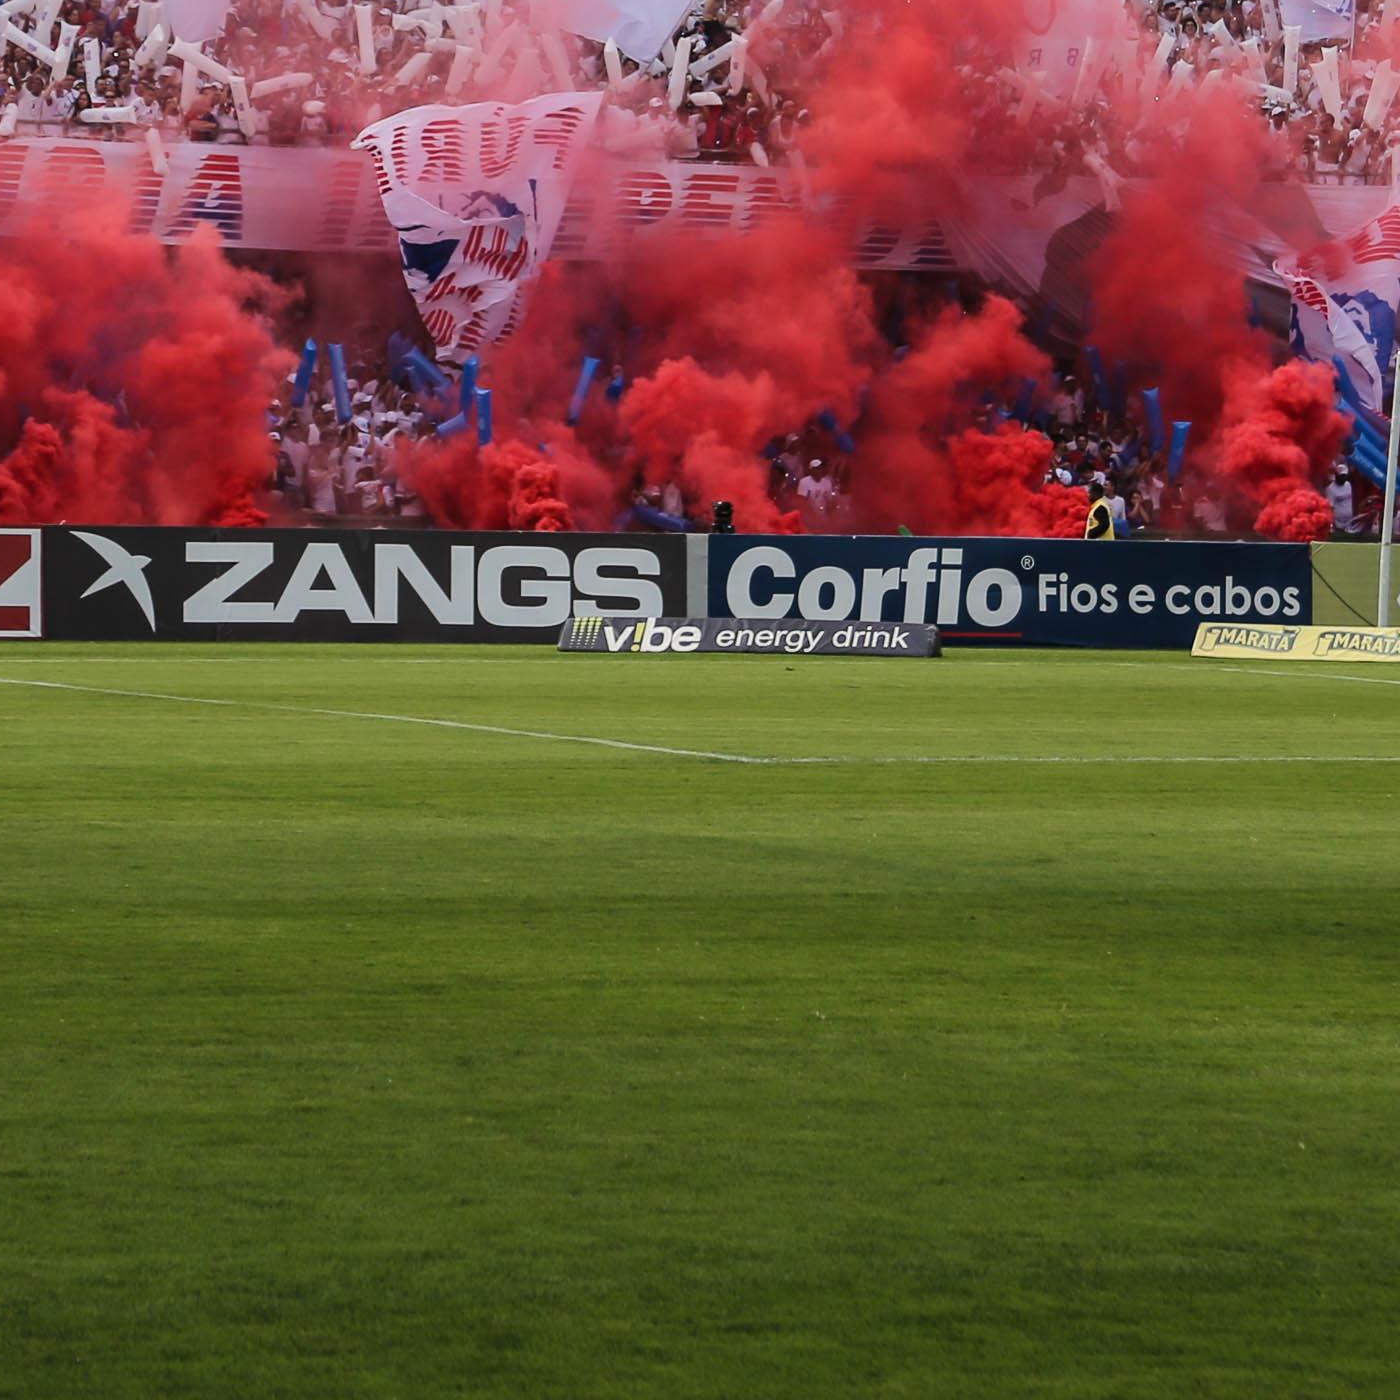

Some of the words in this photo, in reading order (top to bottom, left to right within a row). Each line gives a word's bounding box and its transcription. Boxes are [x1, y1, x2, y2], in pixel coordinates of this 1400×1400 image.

[183, 540, 663, 627] ZANGS
[1038, 573, 1117, 614] Fios
[1128, 587, 1155, 614] e
[1164, 575, 1301, 617] cabos
[716, 626, 824, 654] energy
[833, 624, 910, 650] drink
